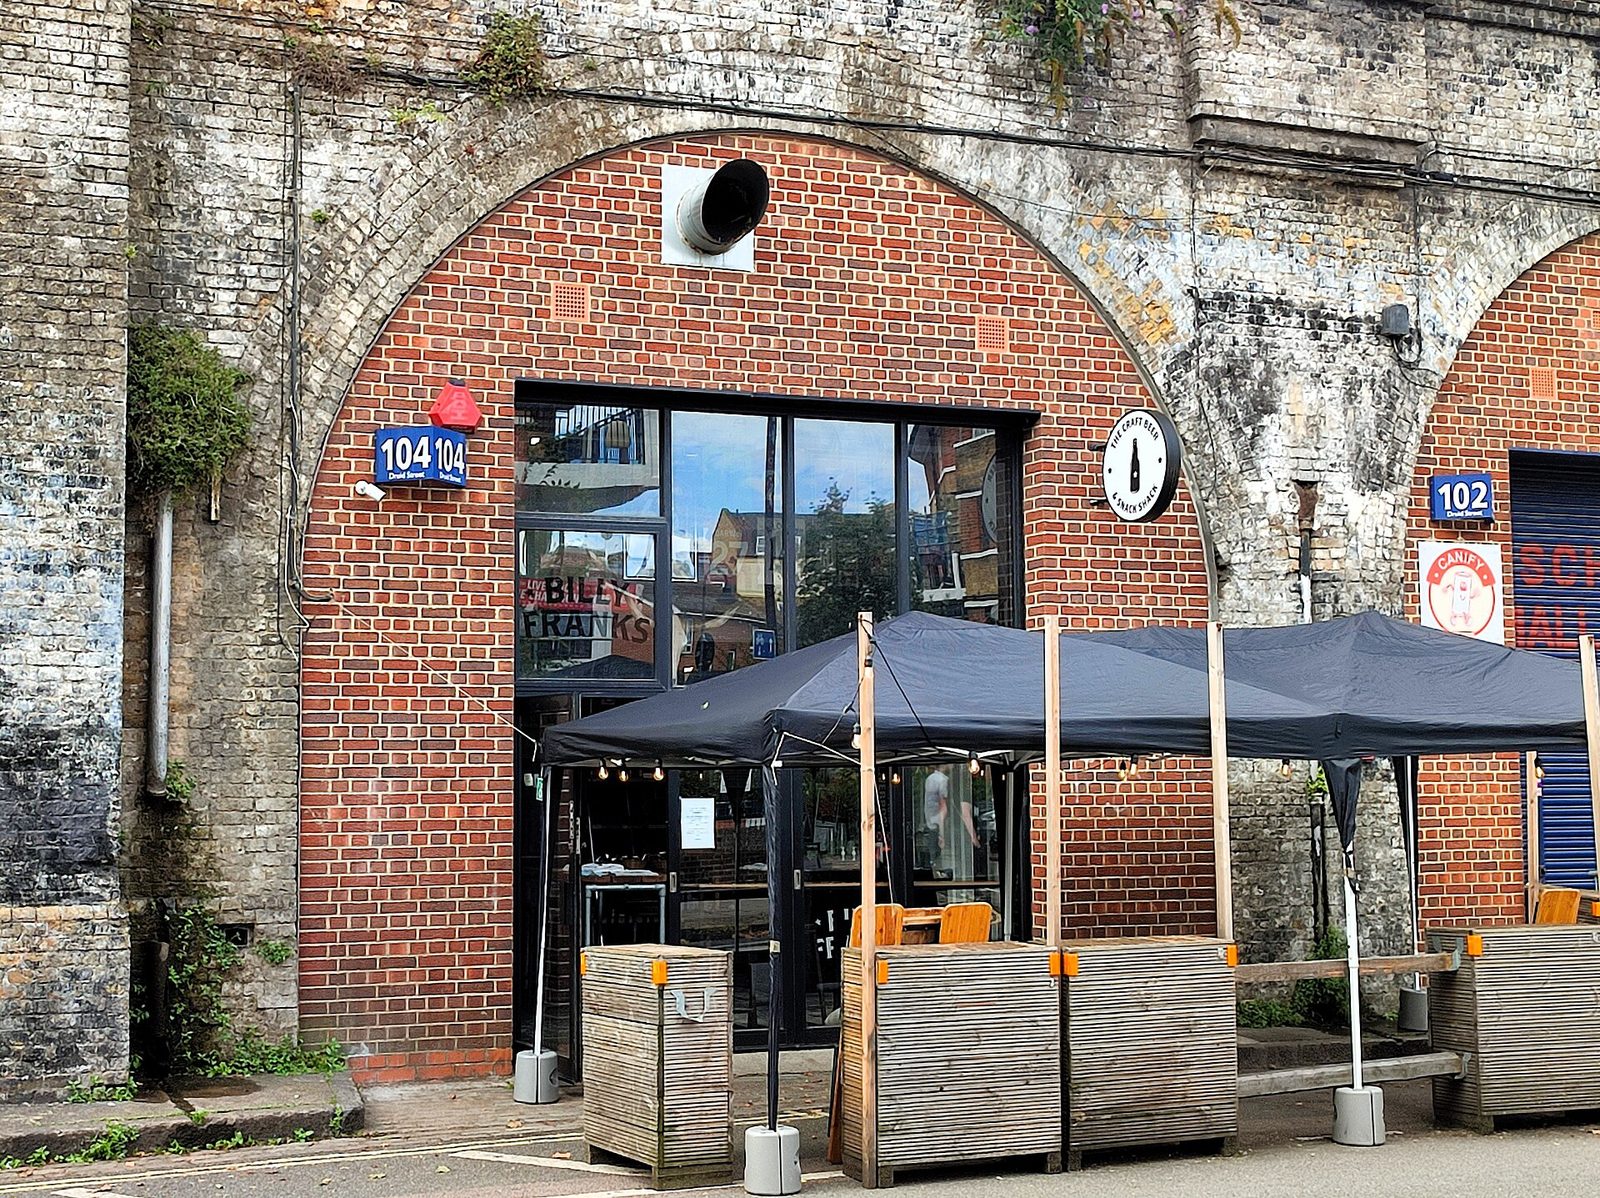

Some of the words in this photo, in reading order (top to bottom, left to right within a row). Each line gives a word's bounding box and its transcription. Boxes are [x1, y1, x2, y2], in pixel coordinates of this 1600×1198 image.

[1110, 429, 1123, 449] THE
[1122, 417, 1143, 432] CRAFT
[1143, 419, 1159, 441] BEER
[381, 436, 432, 471] 104
[434, 437, 465, 475] 104
[388, 471, 406, 480] Druid
[406, 471, 426, 479] Street
[1116, 498, 1138, 514] SNACK
[1138, 485, 1158, 512] SHACK
[1438, 481, 1489, 511] 102
[1437, 550, 1486, 571] CANIFY
[522, 608, 651, 644] FRANKS
